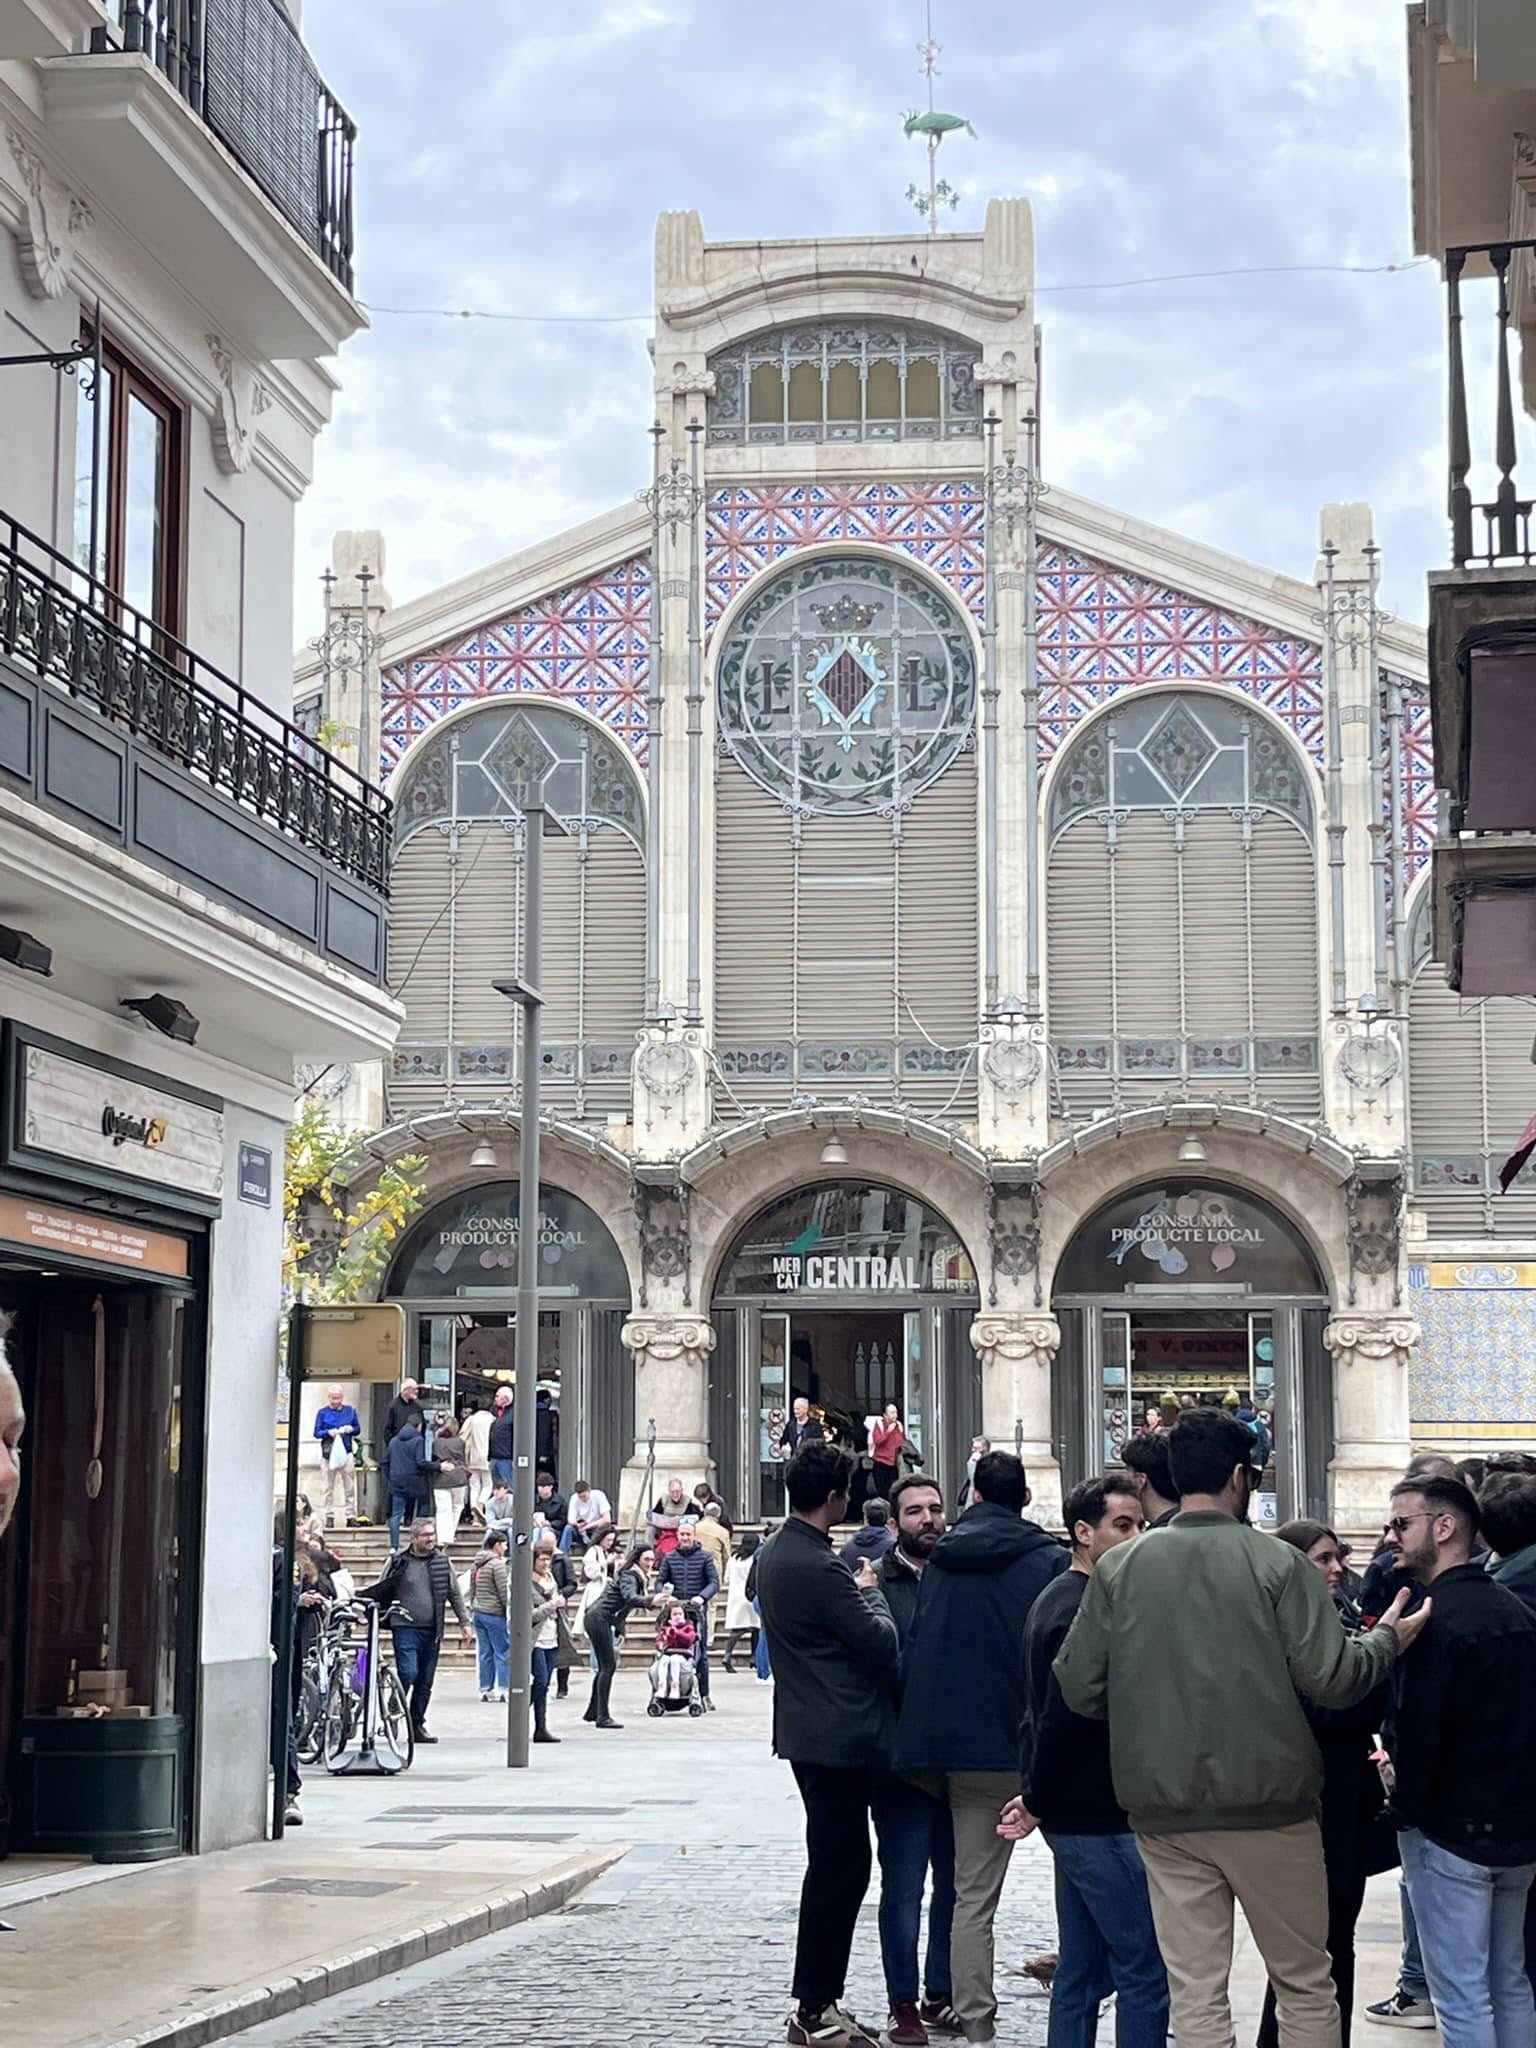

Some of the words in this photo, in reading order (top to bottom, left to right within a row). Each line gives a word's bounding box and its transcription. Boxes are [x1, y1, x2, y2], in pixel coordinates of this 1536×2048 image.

[1139, 1214, 1235, 1228] CONSUMIX
[439, 1231, 519, 1245] PRODUCT
[1111, 1228, 1206, 1242] PRODUCTE
[1207, 1228, 1265, 1242] LOCAL
[773, 1257, 801, 1273] MER
[806, 1256, 921, 1289] CENTRAL
[776, 1273, 800, 1289] CAT
